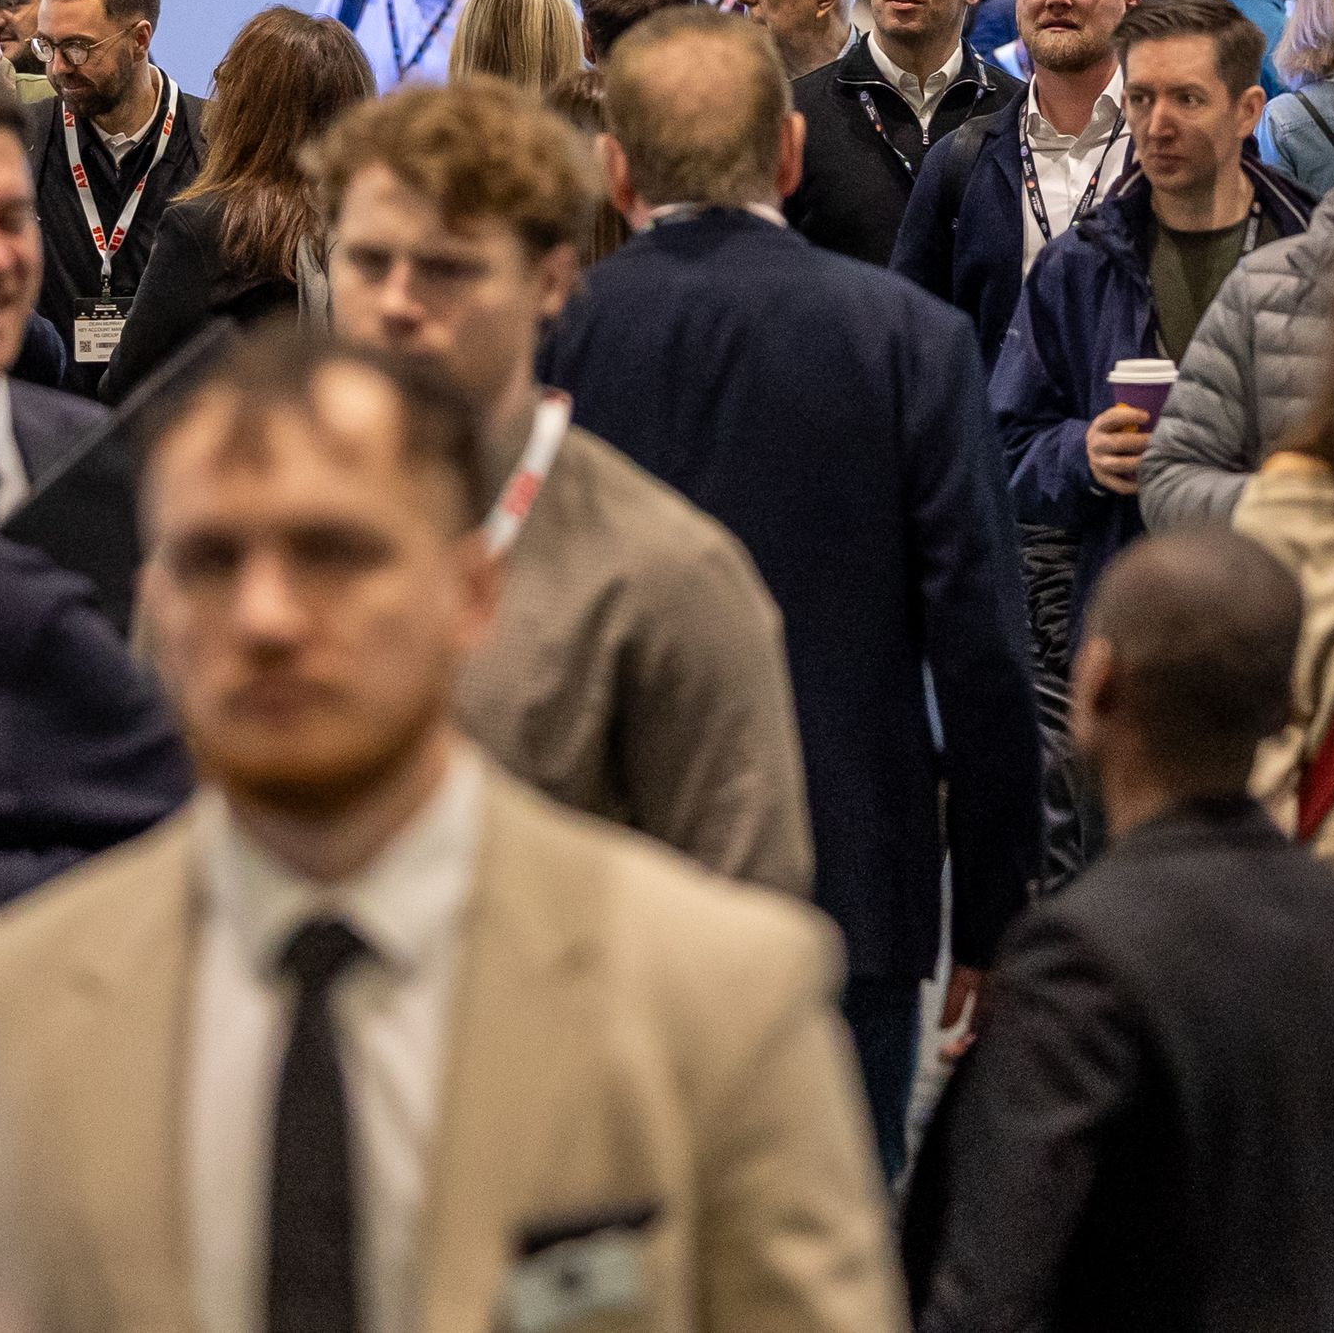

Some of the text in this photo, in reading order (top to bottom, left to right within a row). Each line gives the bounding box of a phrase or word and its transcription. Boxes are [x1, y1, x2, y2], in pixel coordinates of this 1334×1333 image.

[163, 112, 173, 136] ABB
[72, 163, 89, 189] ABB
[92, 226, 107, 252] ABB
[109, 226, 126, 252] ABB
